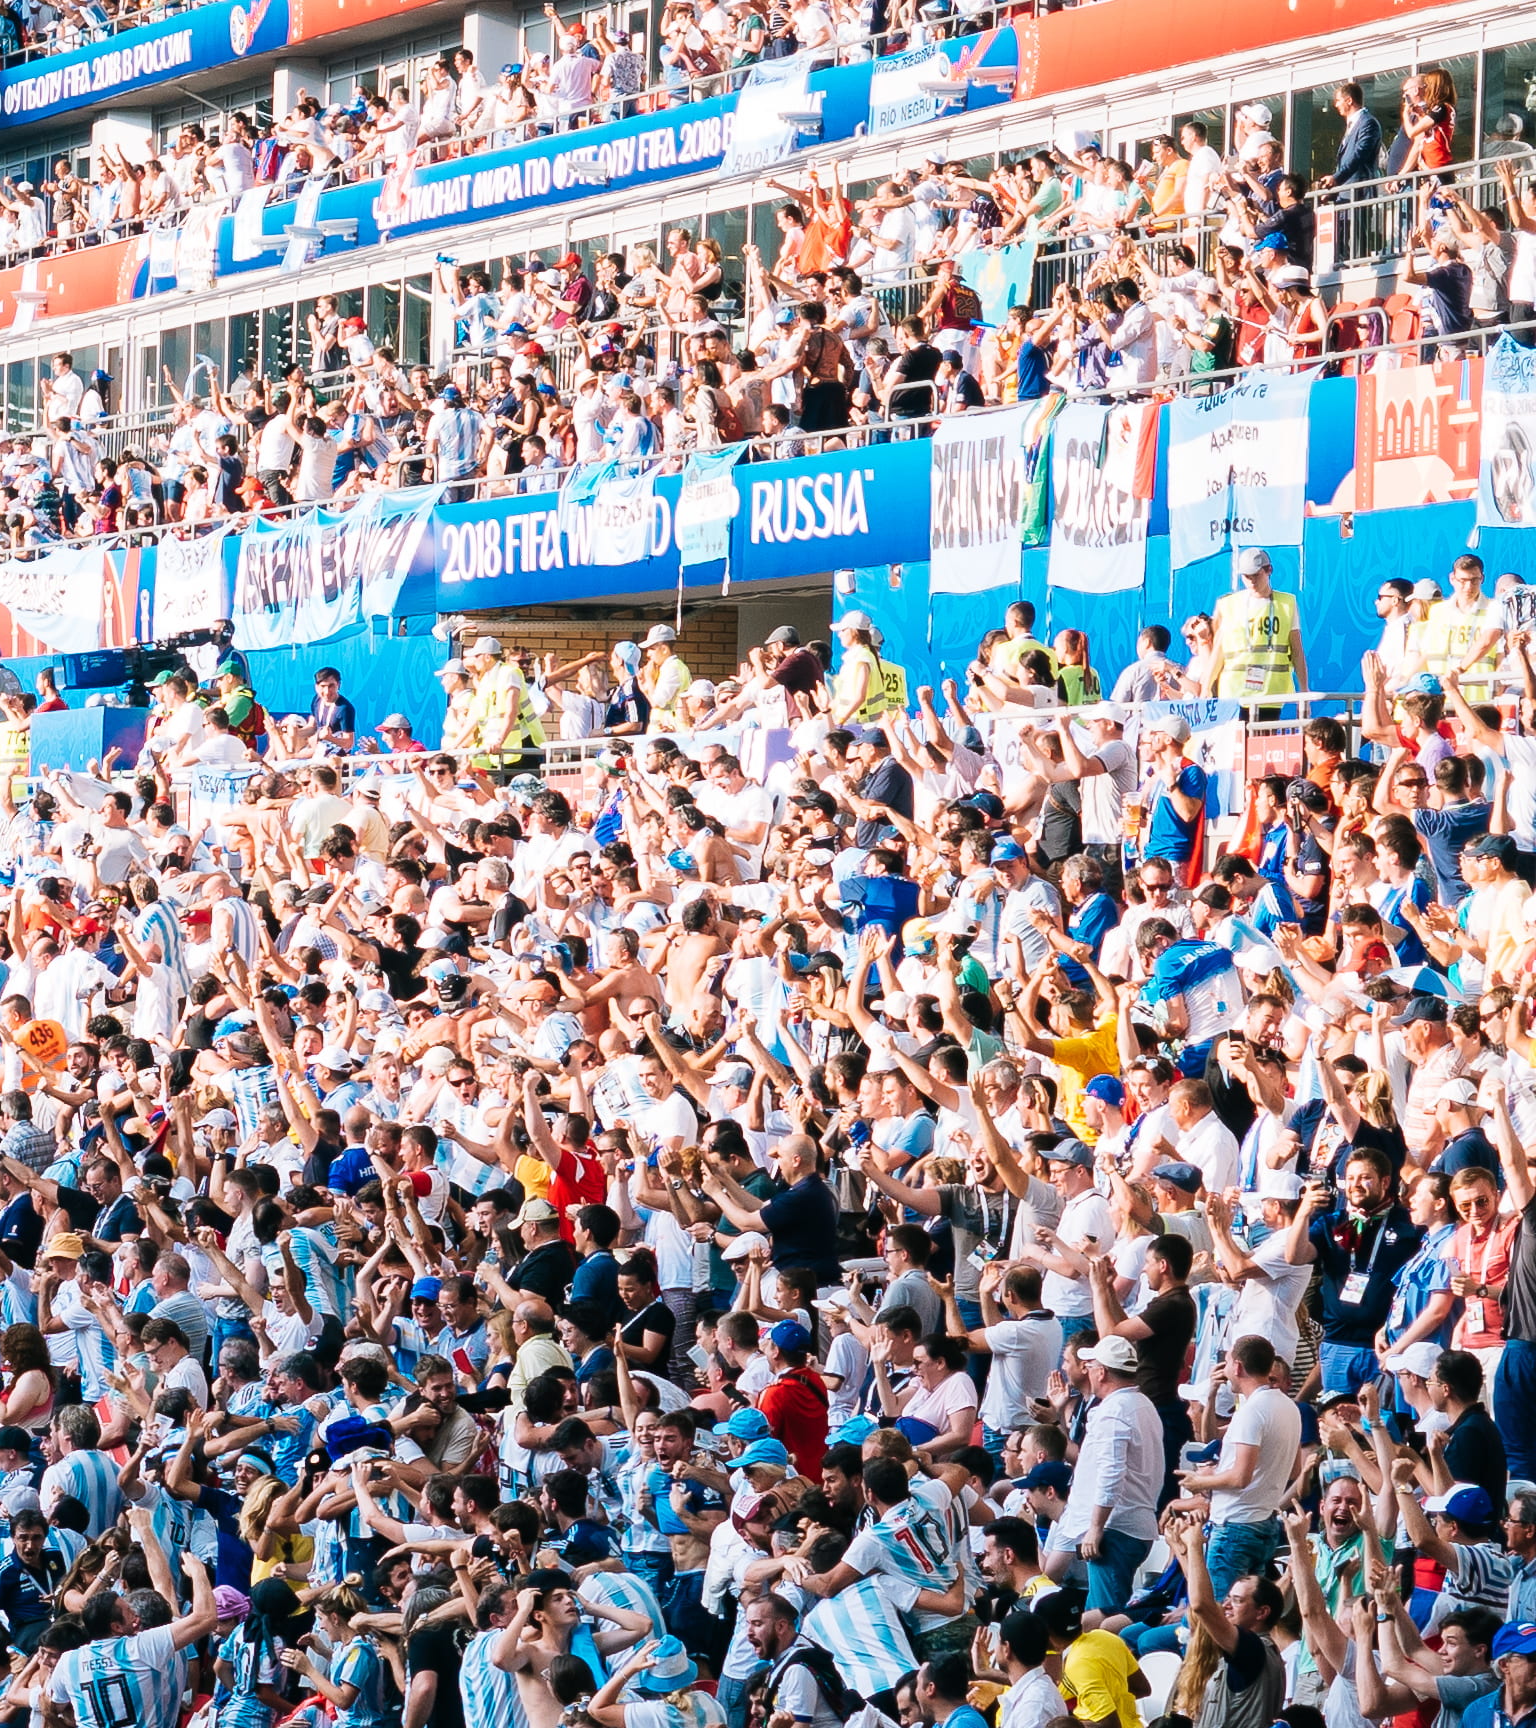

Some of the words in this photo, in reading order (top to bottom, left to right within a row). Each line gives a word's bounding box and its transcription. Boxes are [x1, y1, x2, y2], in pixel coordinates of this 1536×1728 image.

[4, 72, 62, 114] ФУТБОЛУ
[63, 62, 91, 98] FIFA
[91, 55, 122, 94] 2018
[134, 30, 193, 76] РОССИИ
[472, 158, 517, 207] МИРА
[520, 153, 549, 198] ПО
[639, 121, 677, 174] FIFA
[677, 115, 724, 167] 2018
[442, 520, 502, 582] 2018
[505, 510, 562, 573] FIFA
[27, 1024, 55, 1048] 436
[894, 1513, 950, 1575] 10
[80, 1656, 115, 1671] MESSI
